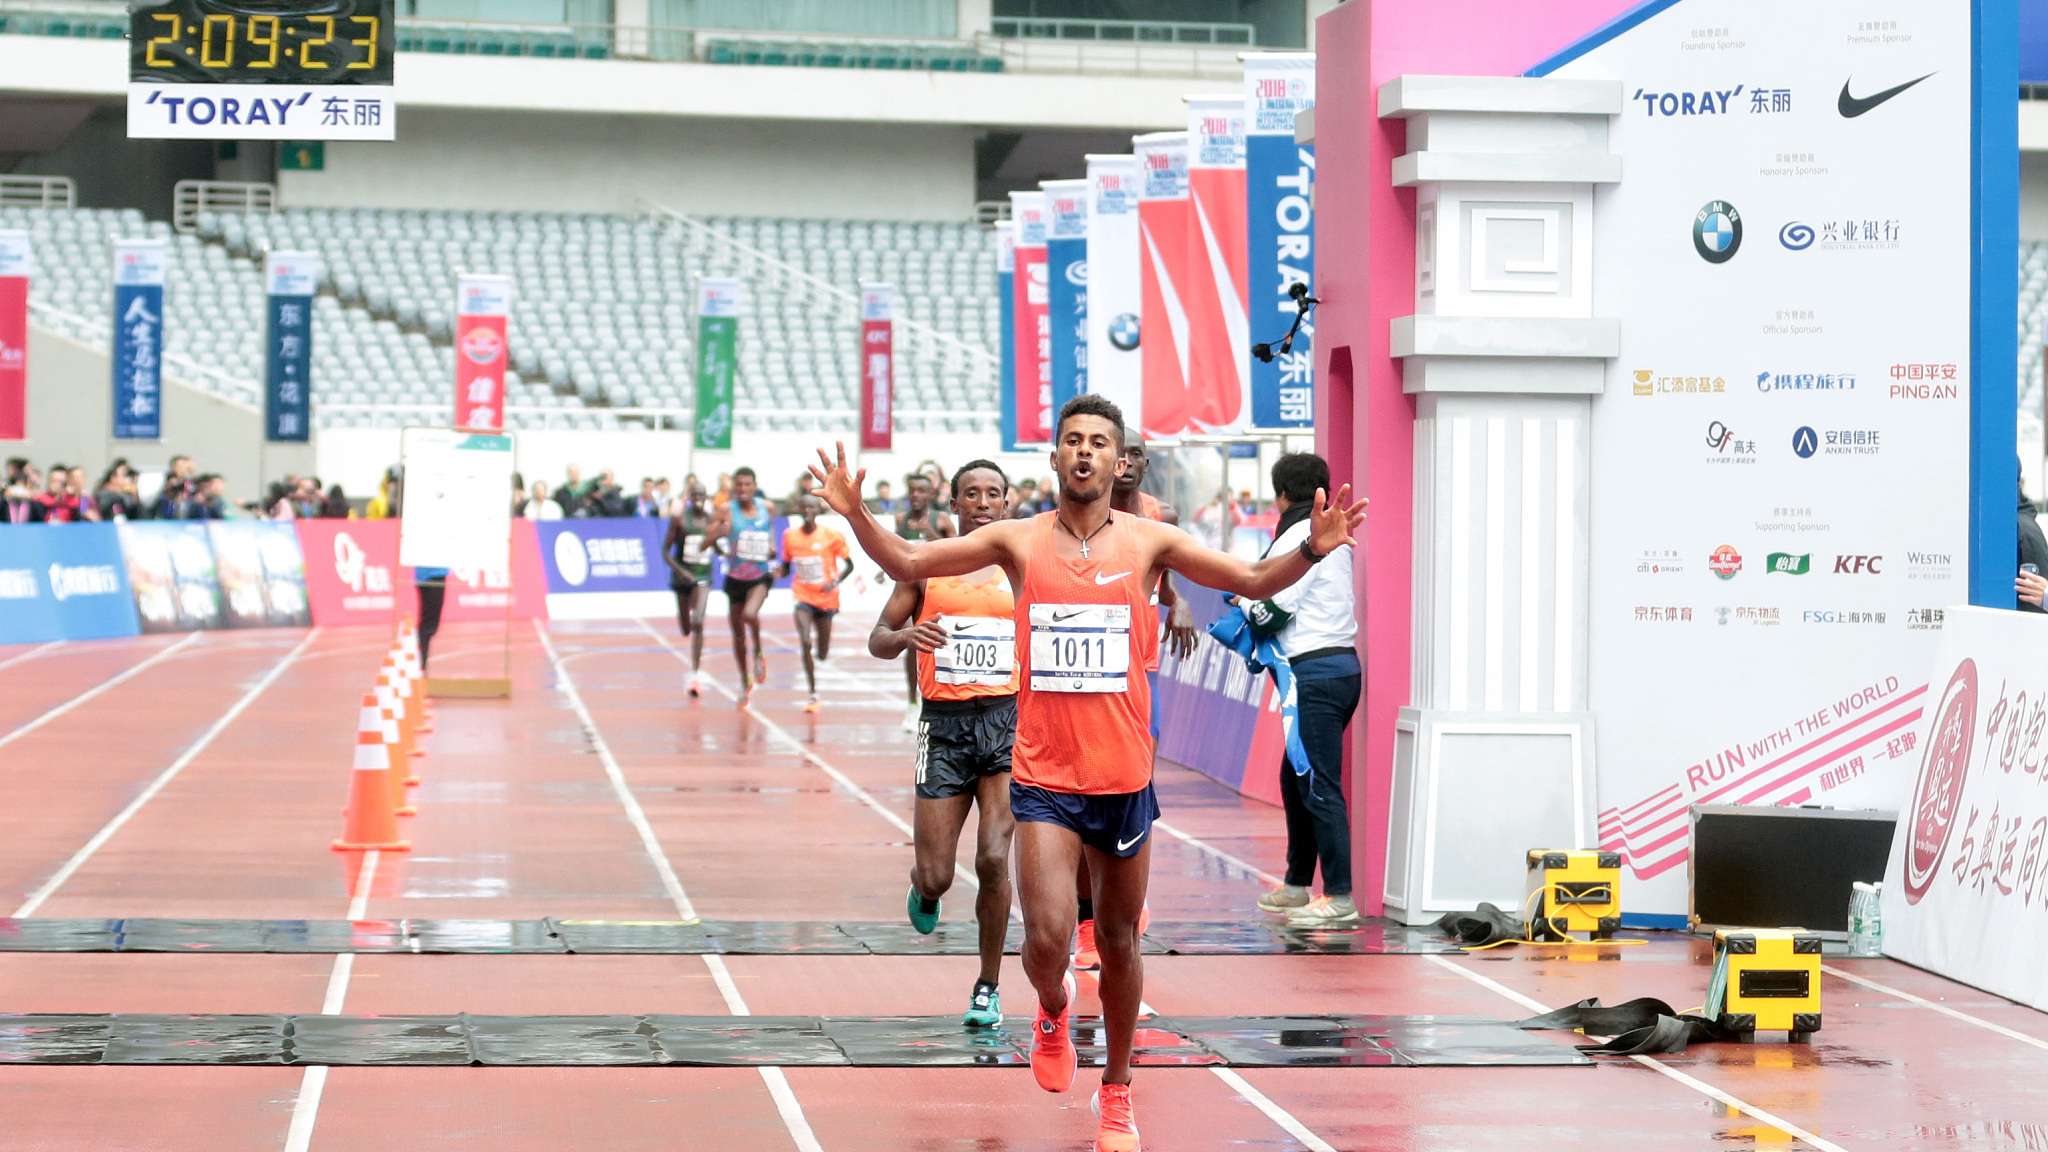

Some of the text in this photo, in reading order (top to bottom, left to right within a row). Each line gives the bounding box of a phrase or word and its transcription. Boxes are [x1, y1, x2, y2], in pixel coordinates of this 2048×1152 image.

[146, 14, 379, 69] 2:09:23
[1256, 79, 1286, 98] 2018
[1750, 88, 1791, 114] 东丽
[321, 96, 381, 126] 东丽
[1698, 201, 1739, 223] BMW
[1821, 219, 1900, 241] 兴业银行
[1774, 373, 1856, 391] 携程旅行
[1890, 364, 1957, 381] 中国平安
[1657, 376, 1726, 393] 汇添富基金
[1734, 440, 1757, 454] 高夫
[1825, 430, 1880, 445] 安信信托
[1825, 446, 1880, 455] ANXIN TRUST
[1833, 555, 1883, 574] KFC
[1634, 605, 1692, 622] 京东体育
[1803, 609, 1834, 624] FSG
[954, 643, 997, 667] 1003
[1051, 637, 1104, 668] 1011
[1686, 675, 1900, 792] RUN WITH THE WORLD
[1818, 730, 1918, 792] 和世界 一起跑
